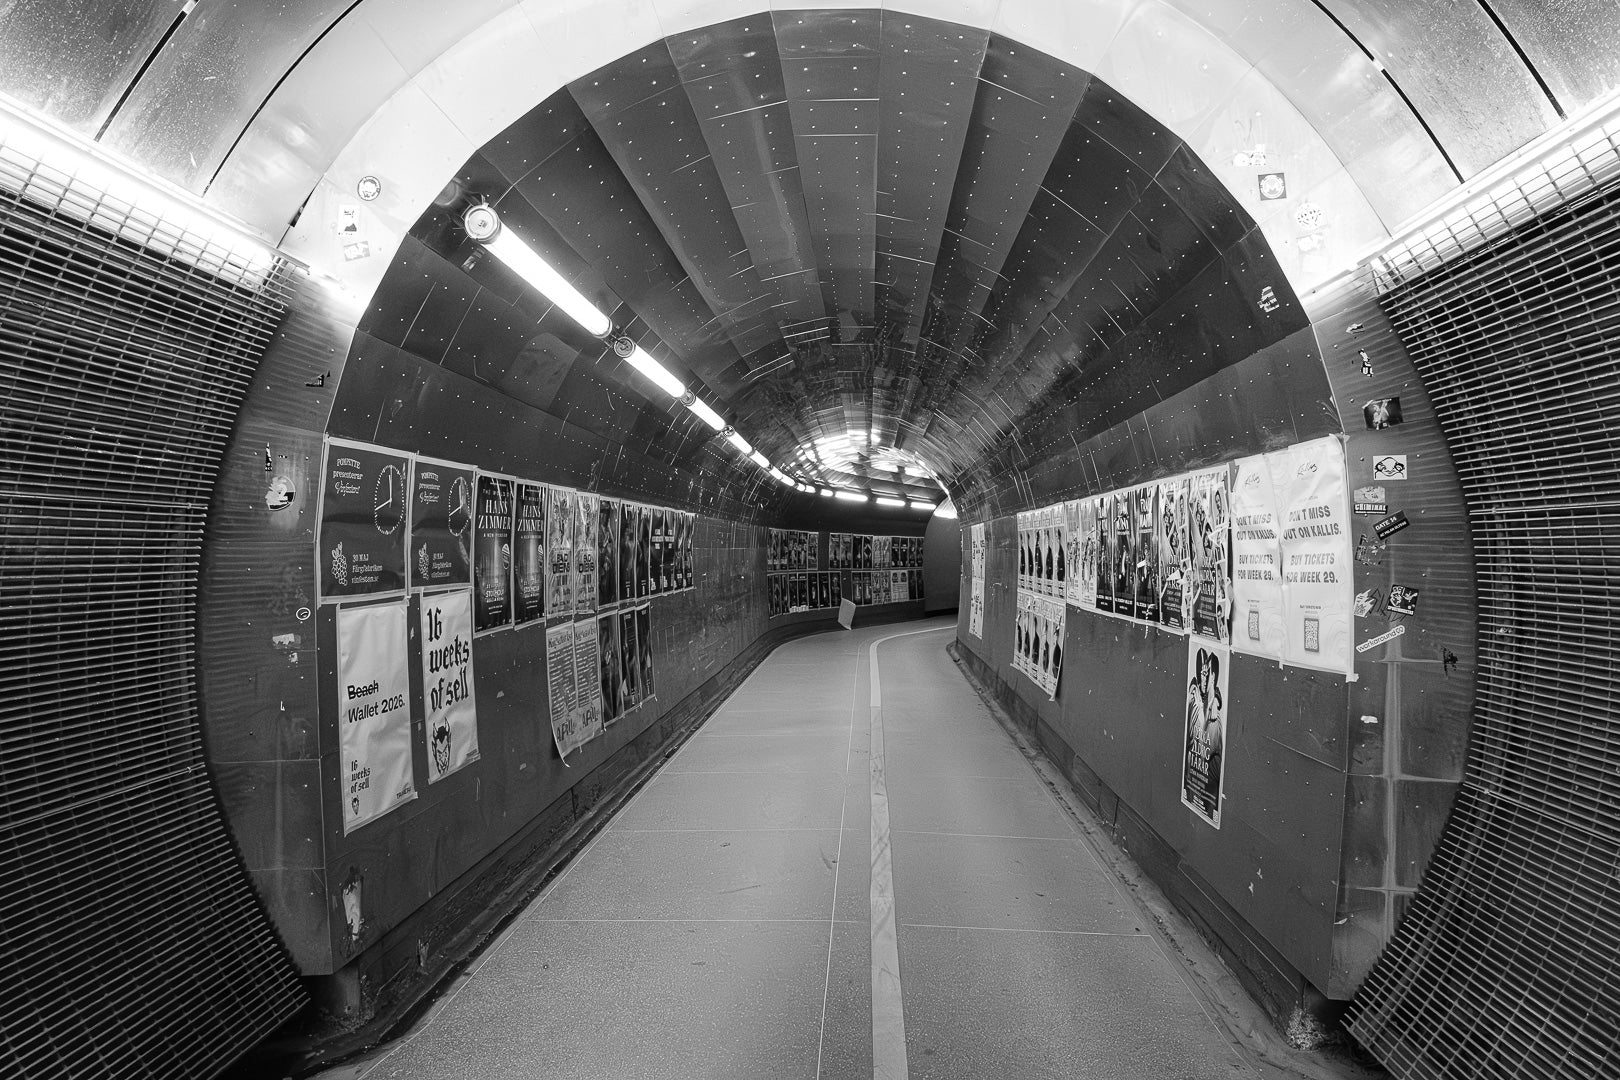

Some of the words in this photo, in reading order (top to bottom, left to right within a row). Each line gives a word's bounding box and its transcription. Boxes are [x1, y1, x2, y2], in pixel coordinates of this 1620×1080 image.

[333, 471, 363, 480] presenterar
[486, 500, 508, 514] HANS
[522, 505, 540, 518] HANS
[1288, 508, 1307, 522] DON'T
[1308, 506, 1331, 519] MISS
[478, 515, 510, 530] ZIMMER
[1252, 513, 1272, 525] MISS
[1375, 520, 1390, 530] GATE
[1236, 530, 1248, 541] OUT
[1248, 530, 1256, 540] ON
[1256, 528, 1277, 540] KALLIS.
[1283, 526, 1298, 540] OUT
[1298, 526, 1310, 538] ON
[1312, 523, 1342, 538] KALLIS.
[352, 554, 360, 562] 30
[1239, 554, 1249, 564] BUY
[1250, 554, 1274, 564] TICKETS
[1290, 554, 1303, 566] BUY
[1304, 552, 1335, 566] TICKETS
[352, 564, 382, 574] Färgfabriken
[1238, 570, 1246, 580] FOR
[1247, 570, 1263, 580] WEEK
[1263, 570, 1274, 581] 29.
[1286, 572, 1298, 583] FOR
[1300, 571, 1322, 584] WEEK
[1322, 571, 1338, 584] 29.
[426, 607, 442, 642] 16
[1358, 629, 1396, 652] workaround
[429, 634, 470, 674] weeks
[347, 680, 379, 700] Beach
[430, 677, 445, 712] of
[446, 666, 469, 705] sell
[348, 702, 379, 723] Wallet
[381, 694, 405, 714] 2026.
[351, 760, 358, 772] 16
[351, 767, 370, 781] weeks
[350, 782, 358, 794] of
[358, 777, 370, 792] sell
